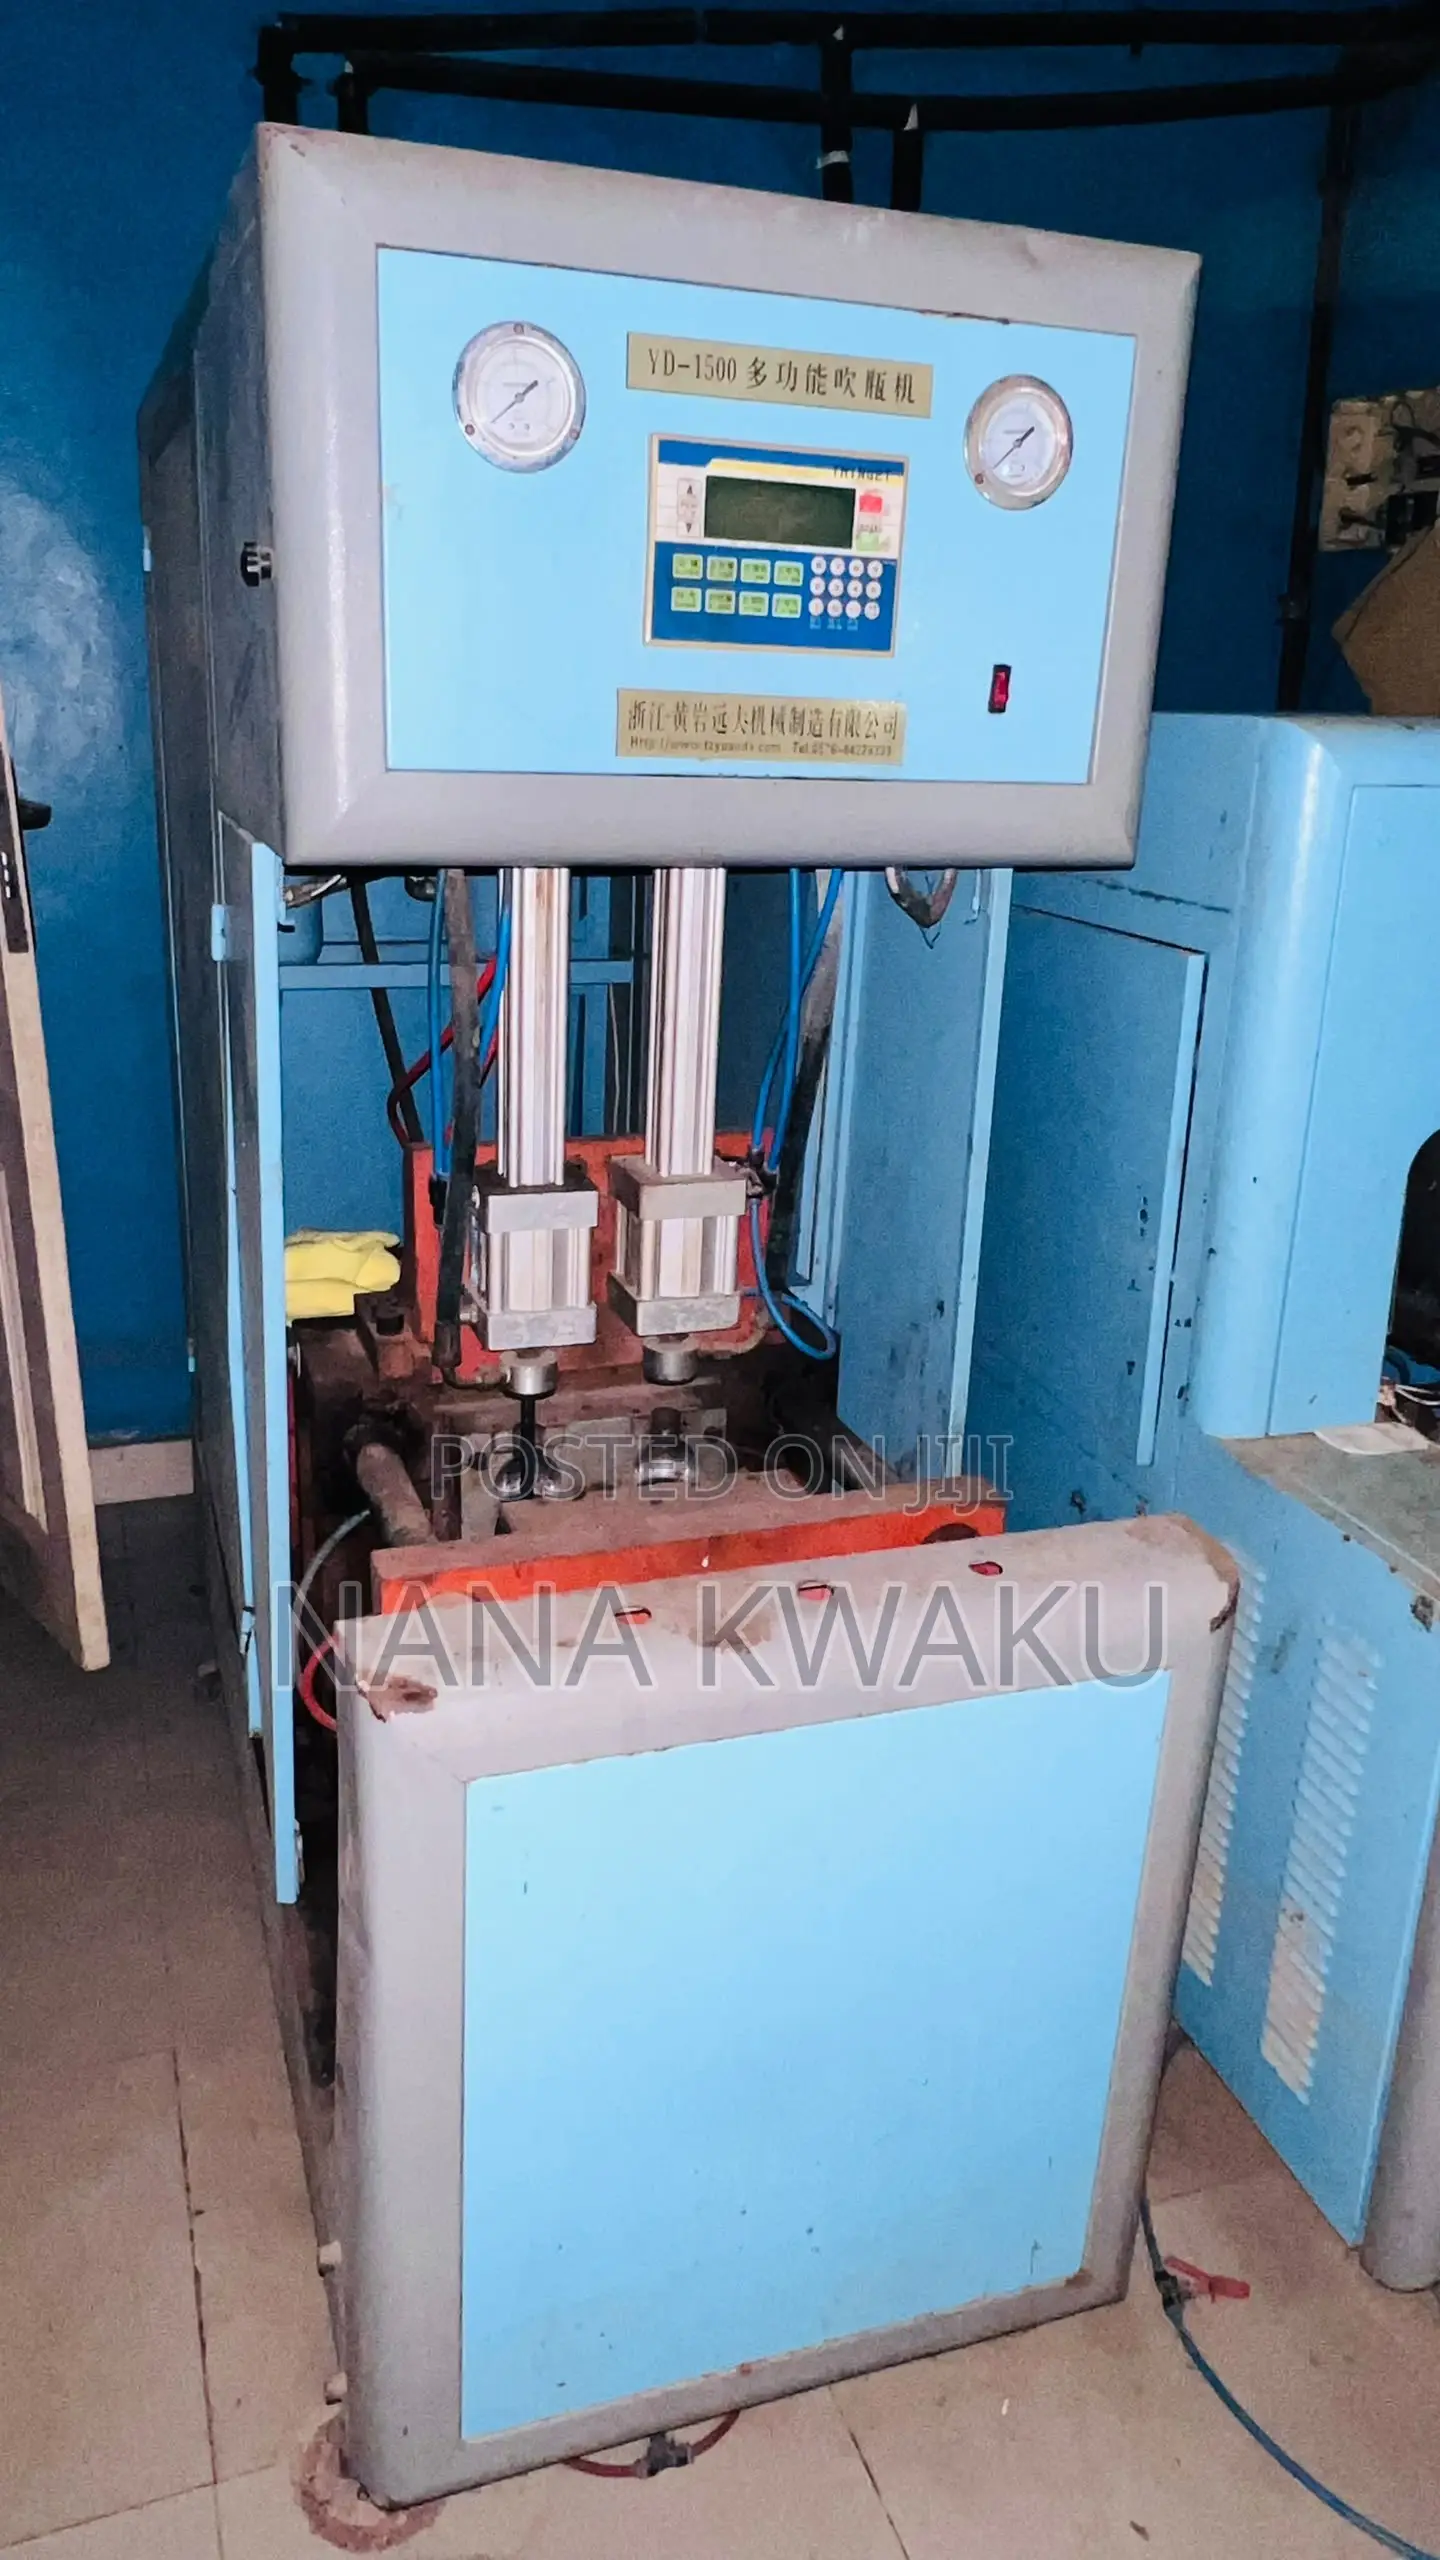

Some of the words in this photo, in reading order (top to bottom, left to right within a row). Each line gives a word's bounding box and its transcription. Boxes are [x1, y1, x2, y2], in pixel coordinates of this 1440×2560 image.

[648, 348, 737, 384] YD-1500
[746, 356, 916, 405] 多功能吹瓶机
